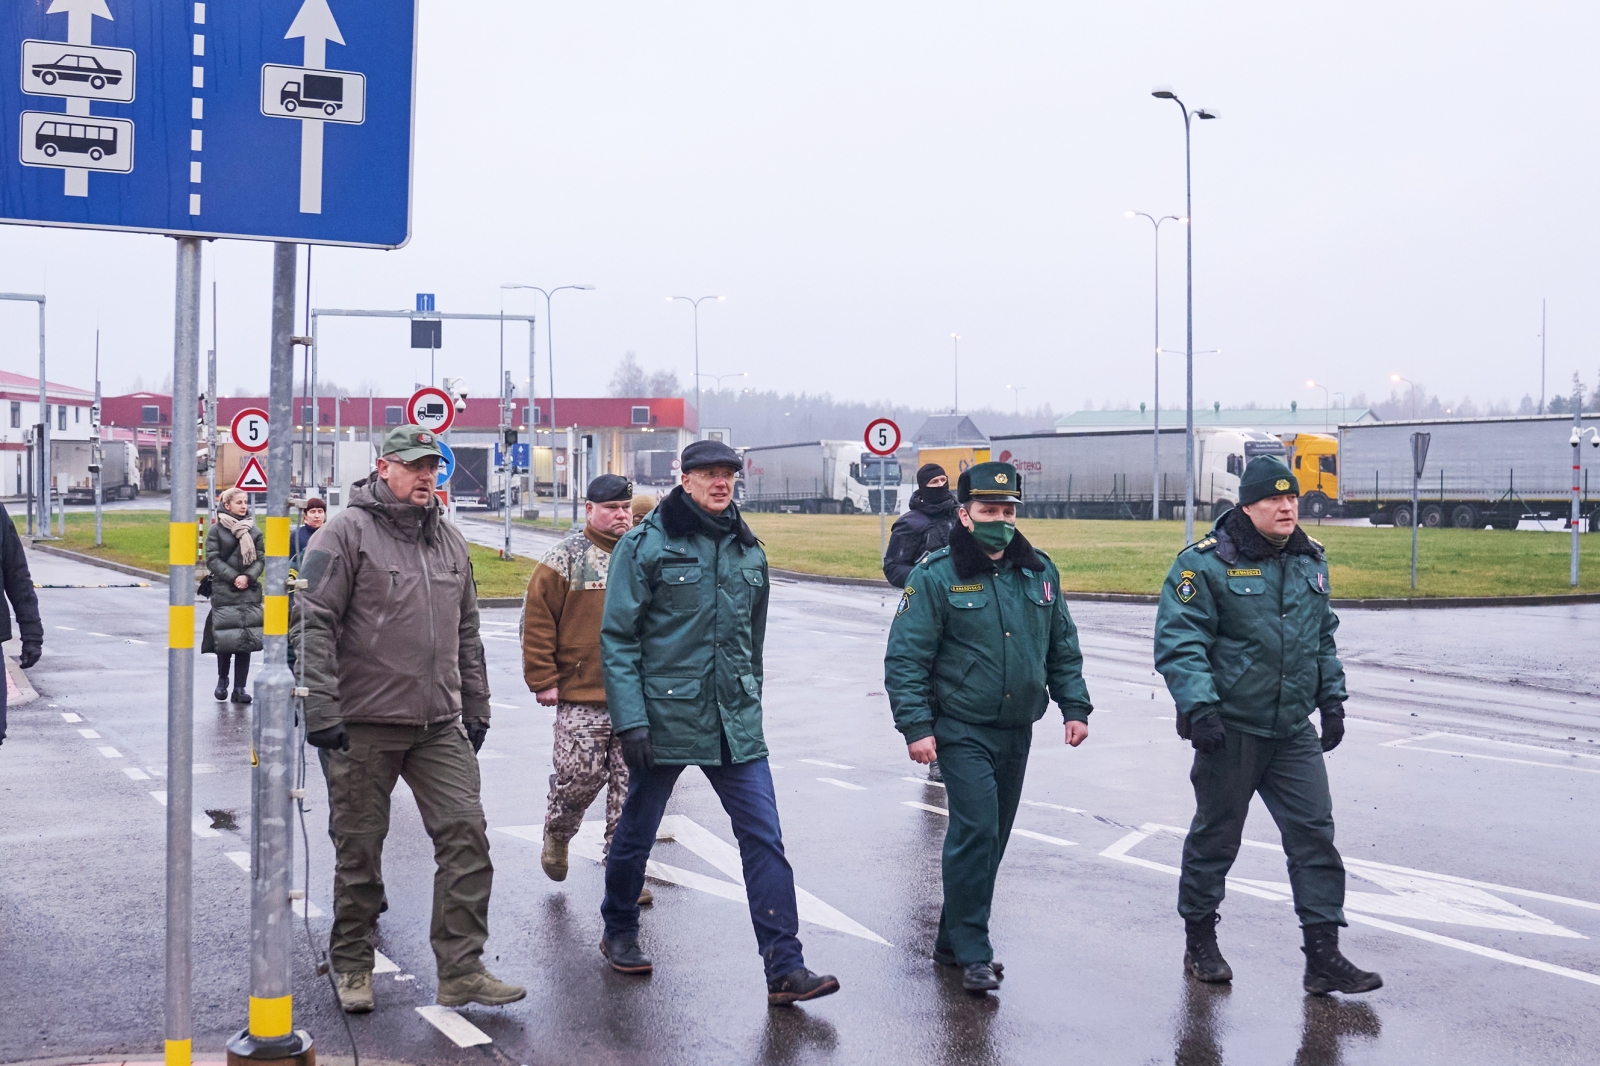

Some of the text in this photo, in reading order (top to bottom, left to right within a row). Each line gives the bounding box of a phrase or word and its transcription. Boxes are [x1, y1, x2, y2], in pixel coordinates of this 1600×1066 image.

[249, 420, 258, 441] 5
[879, 428, 887, 447] 5
[1012, 459, 1042, 471] Girteka
